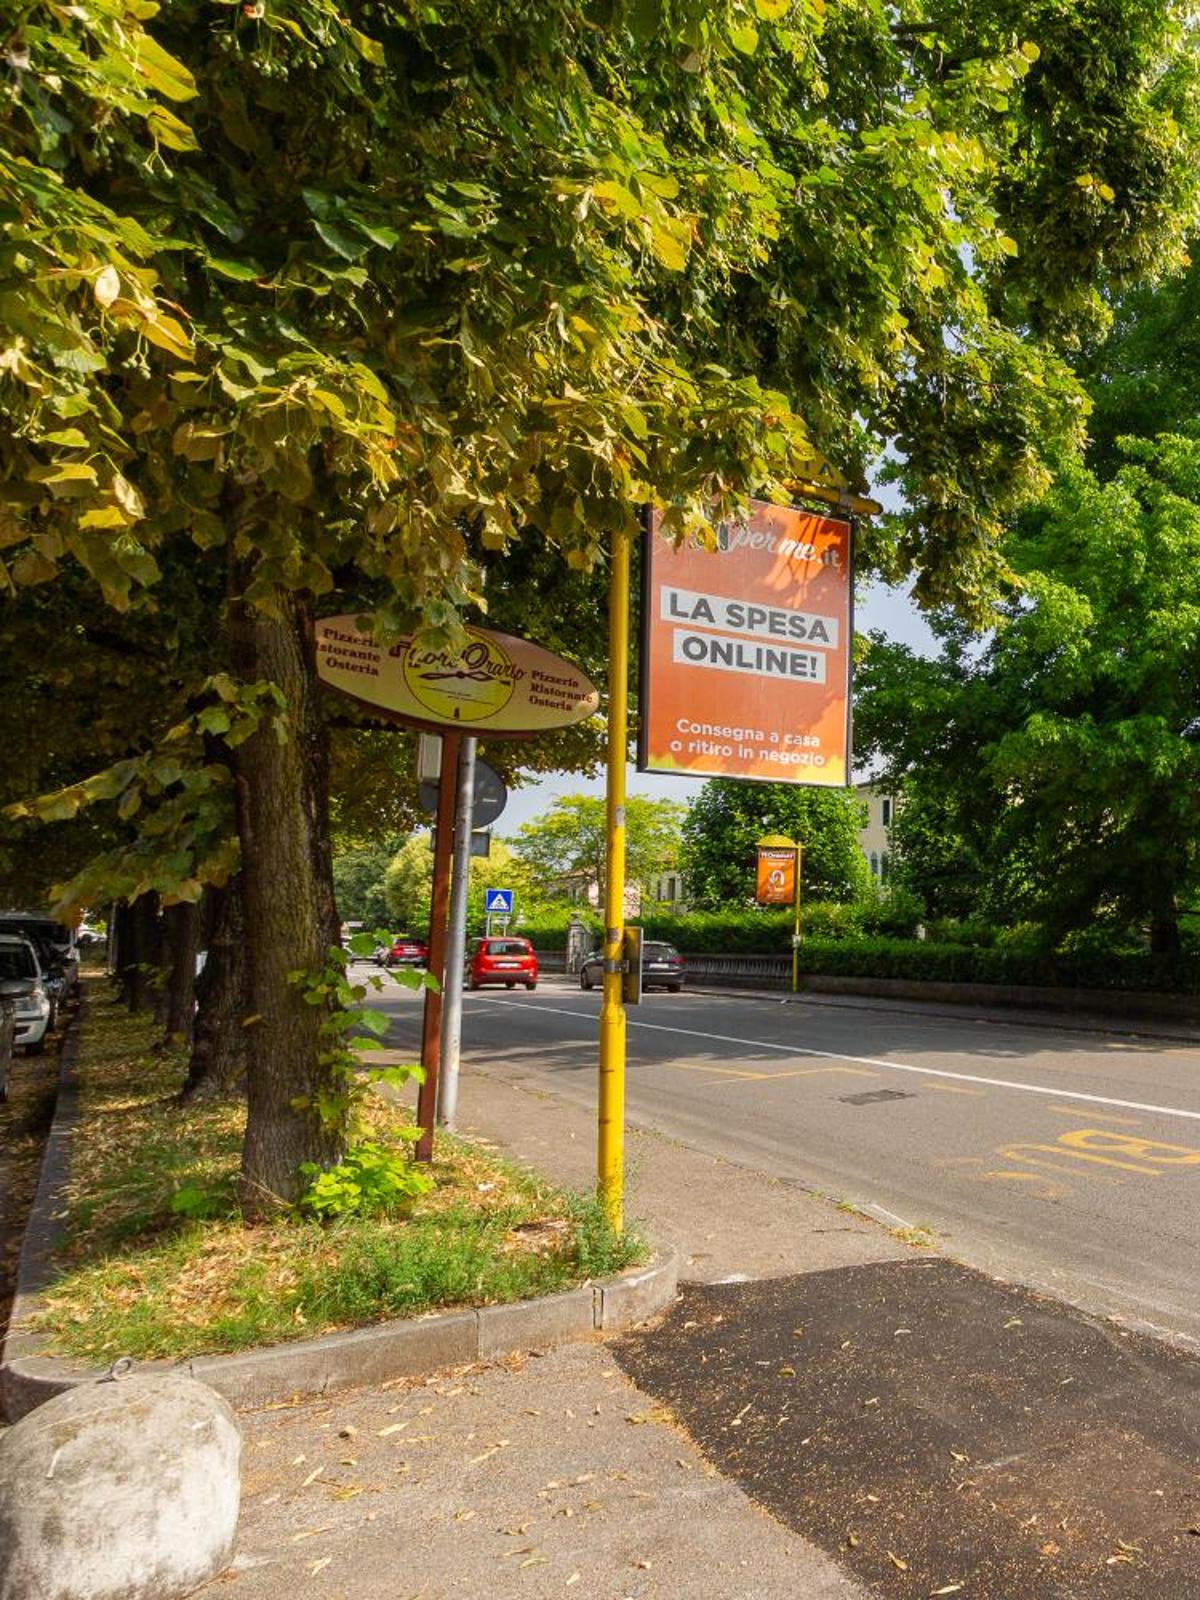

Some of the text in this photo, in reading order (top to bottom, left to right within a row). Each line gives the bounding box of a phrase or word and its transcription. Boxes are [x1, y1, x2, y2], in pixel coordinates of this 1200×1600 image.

[670, 592, 829, 642] LA SPESA
[315, 641, 381, 662] istorante
[682, 636, 817, 678] ONLINE!
[326, 657, 379, 676] Osteria
[531, 670, 579, 688] Pizzeria
[529, 695, 573, 711] Osteria
[530, 682, 593, 703] Ristorante
[676, 719, 820, 747] Consegna a casa
[670, 740, 825, 766] o ritiro in negozio
